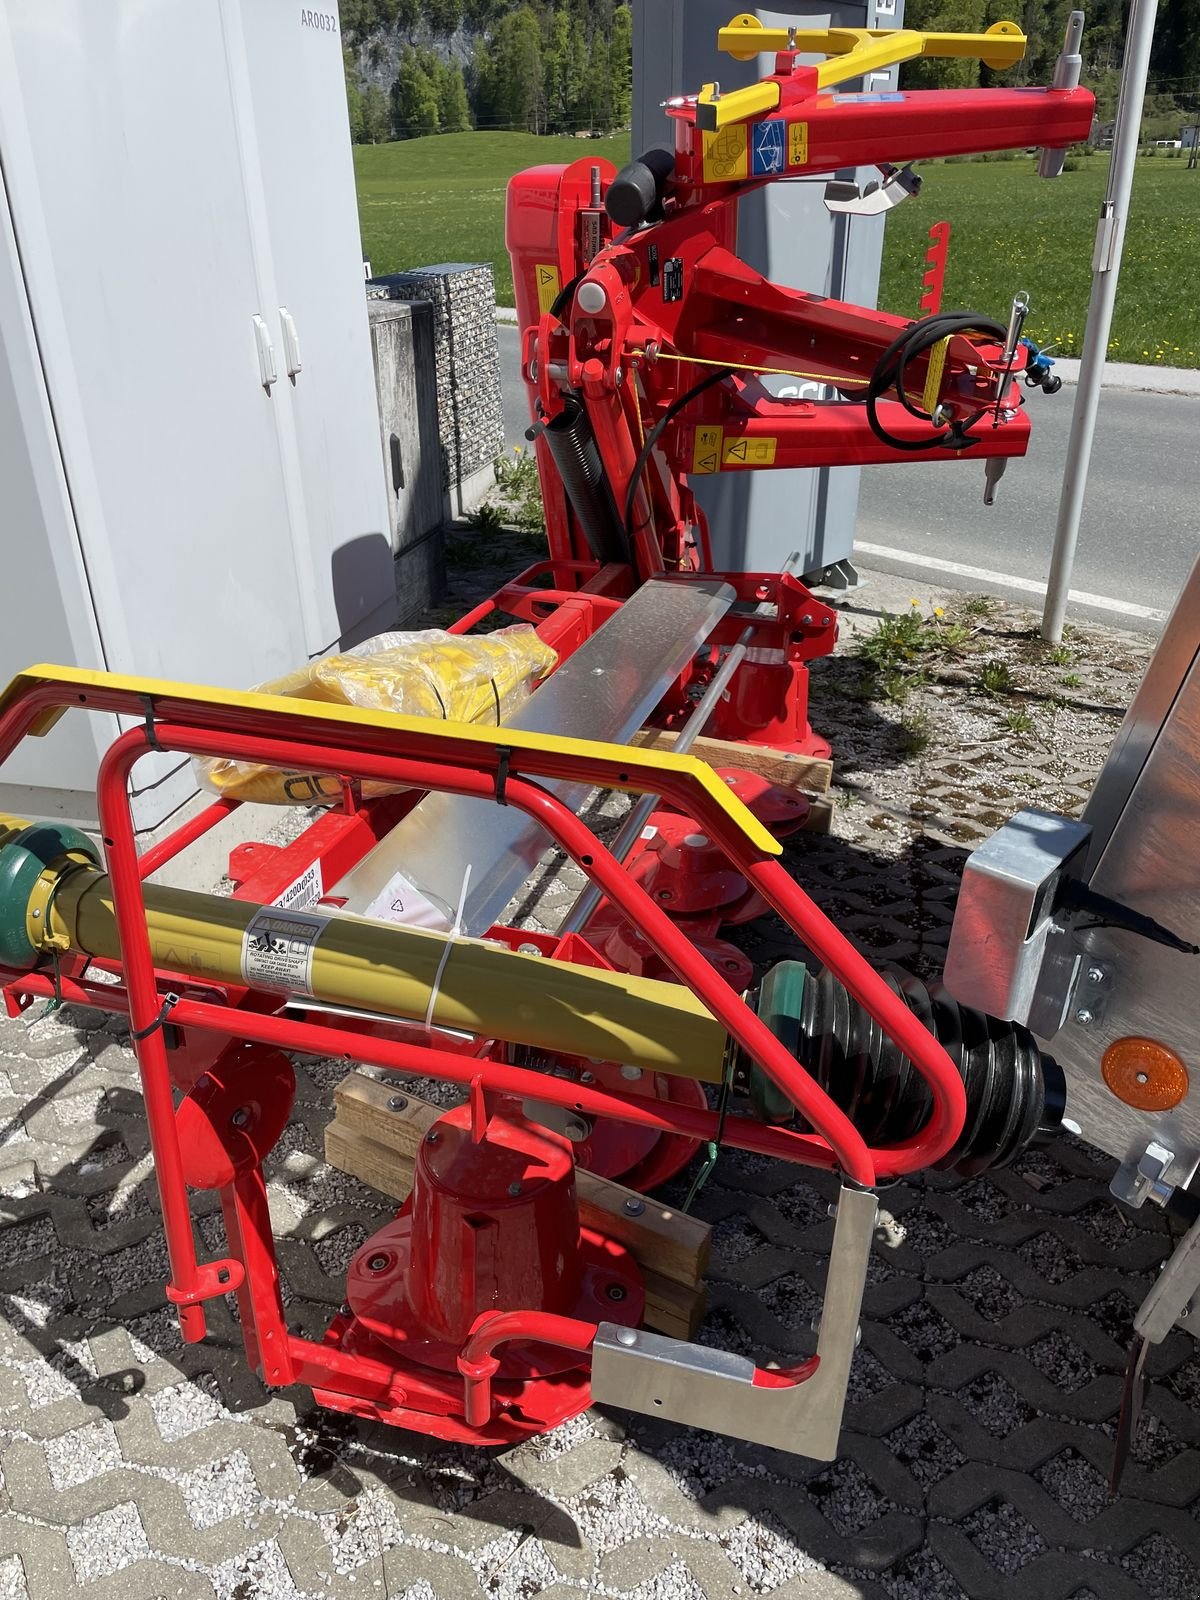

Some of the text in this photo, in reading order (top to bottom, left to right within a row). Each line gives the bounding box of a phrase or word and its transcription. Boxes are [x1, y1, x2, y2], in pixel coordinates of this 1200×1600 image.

[301, 9, 337, 32] AR0032
[271, 920, 316, 935] DANGER
[249, 951, 273, 960] ROTATING
